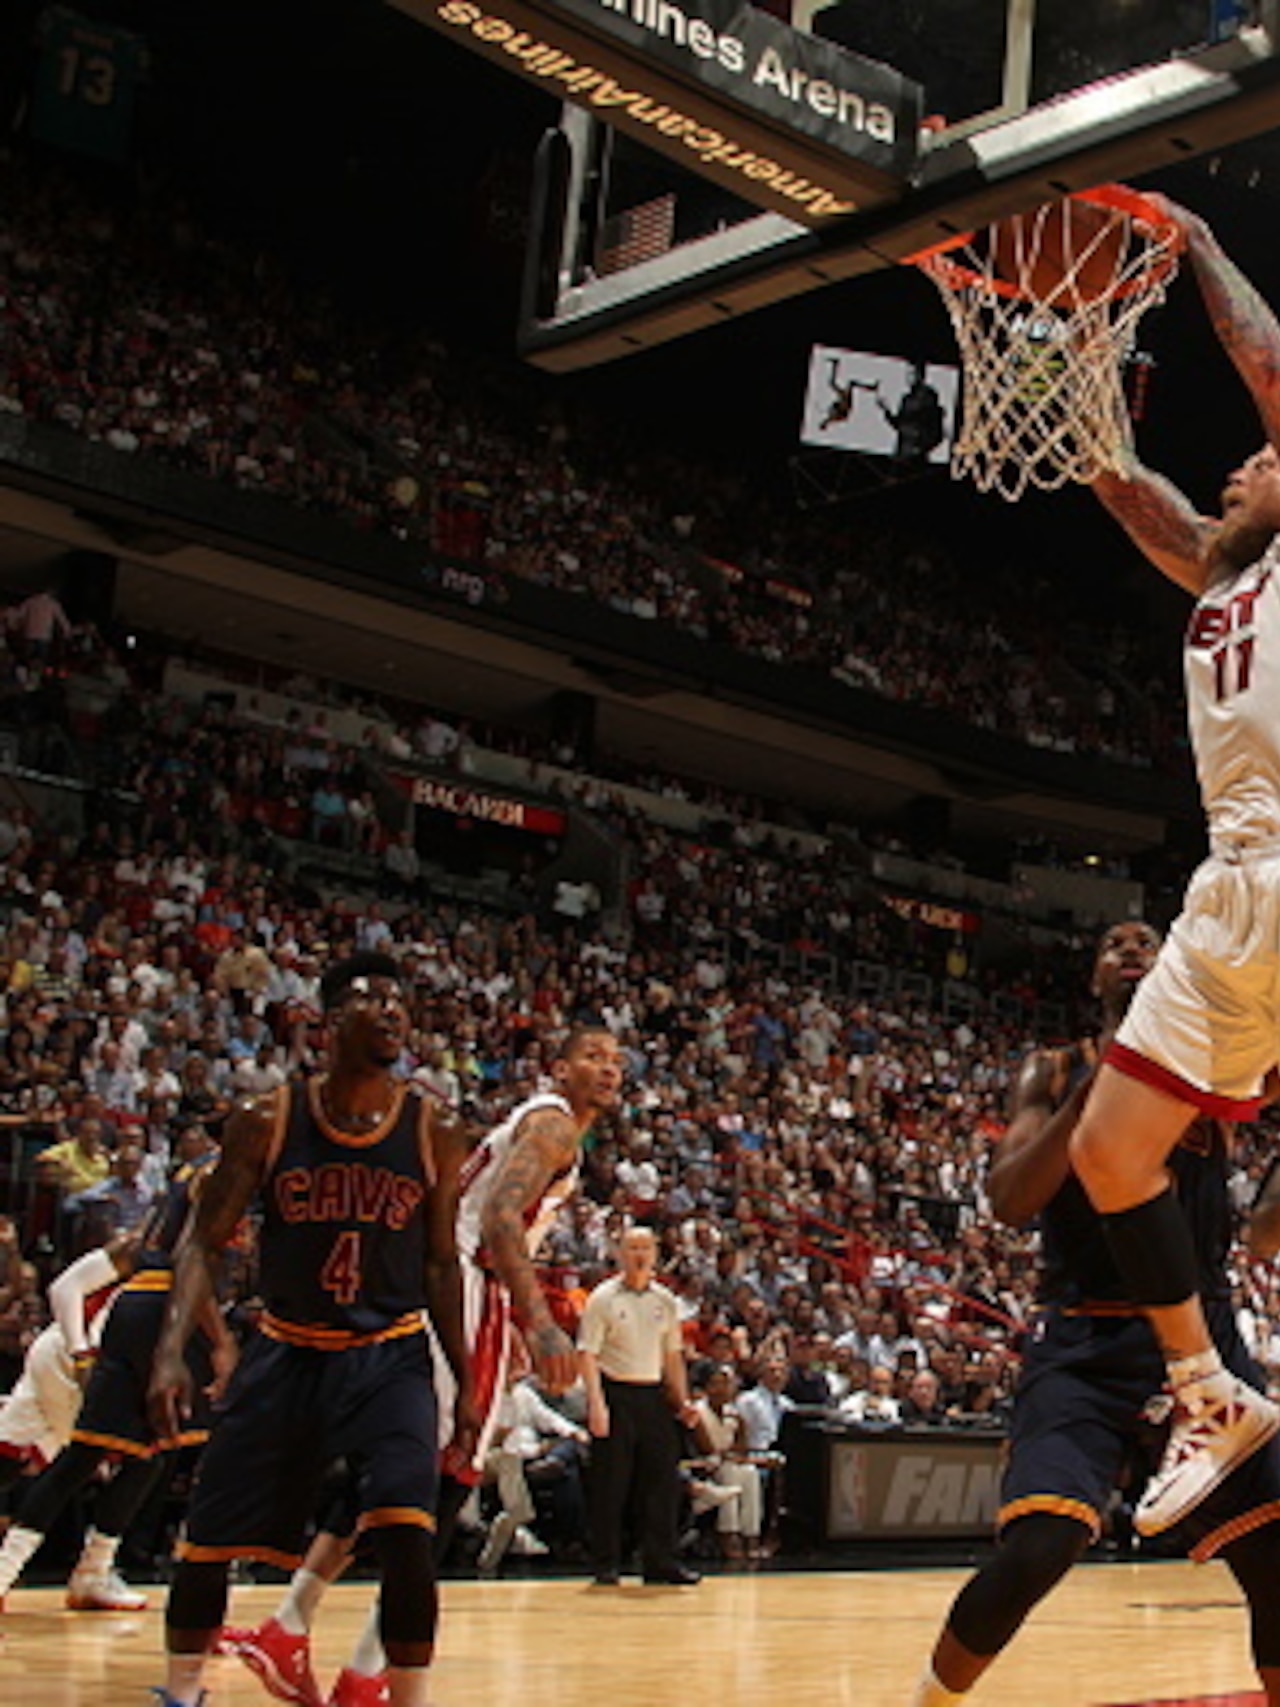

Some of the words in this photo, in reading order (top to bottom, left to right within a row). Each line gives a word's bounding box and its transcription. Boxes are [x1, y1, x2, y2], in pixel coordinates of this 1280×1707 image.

[58, 47, 116, 105] 13
[601, 0, 746, 73] lines
[753, 46, 898, 144] Arena
[436, 0, 858, 216] AmericanAirlines
[1213, 636, 1254, 702] 11
[412, 777, 526, 827] BACARDI
[275, 1162, 425, 1231] CAVS
[320, 1231, 363, 1305] 4
